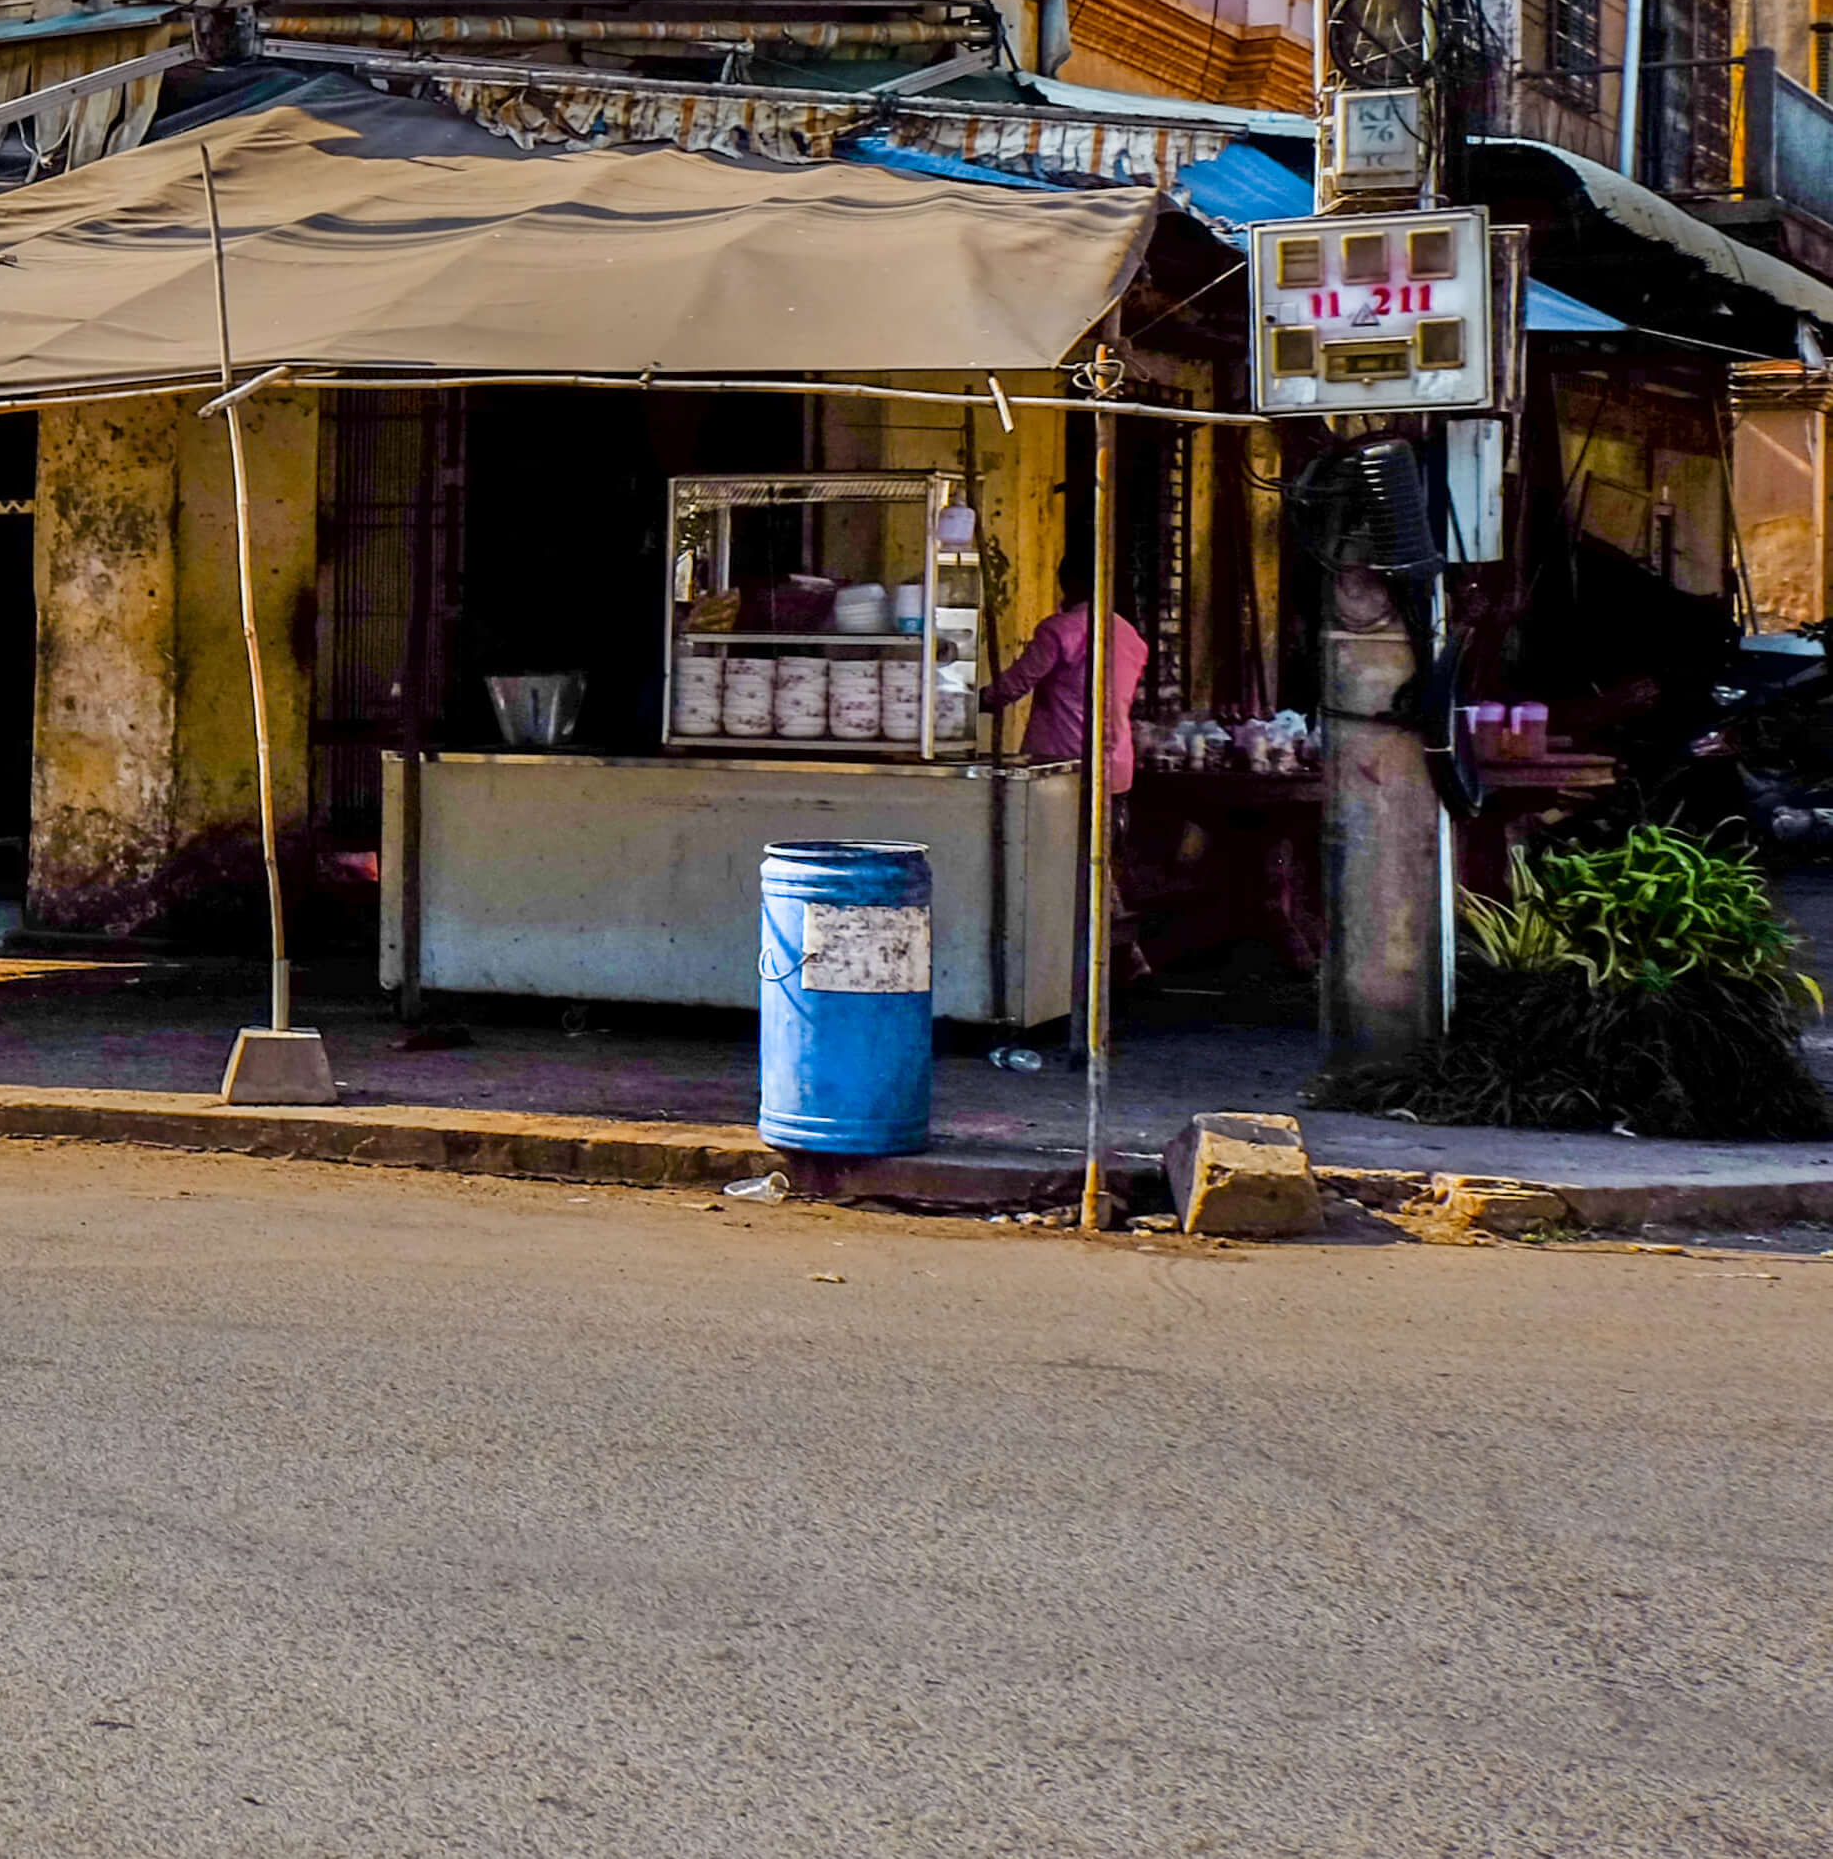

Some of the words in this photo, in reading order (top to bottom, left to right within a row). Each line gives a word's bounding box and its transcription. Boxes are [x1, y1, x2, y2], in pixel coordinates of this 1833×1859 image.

[1361, 123, 1395, 143] 76
[1309, 290, 1341, 319] 11
[1371, 283, 1432, 316] 211
